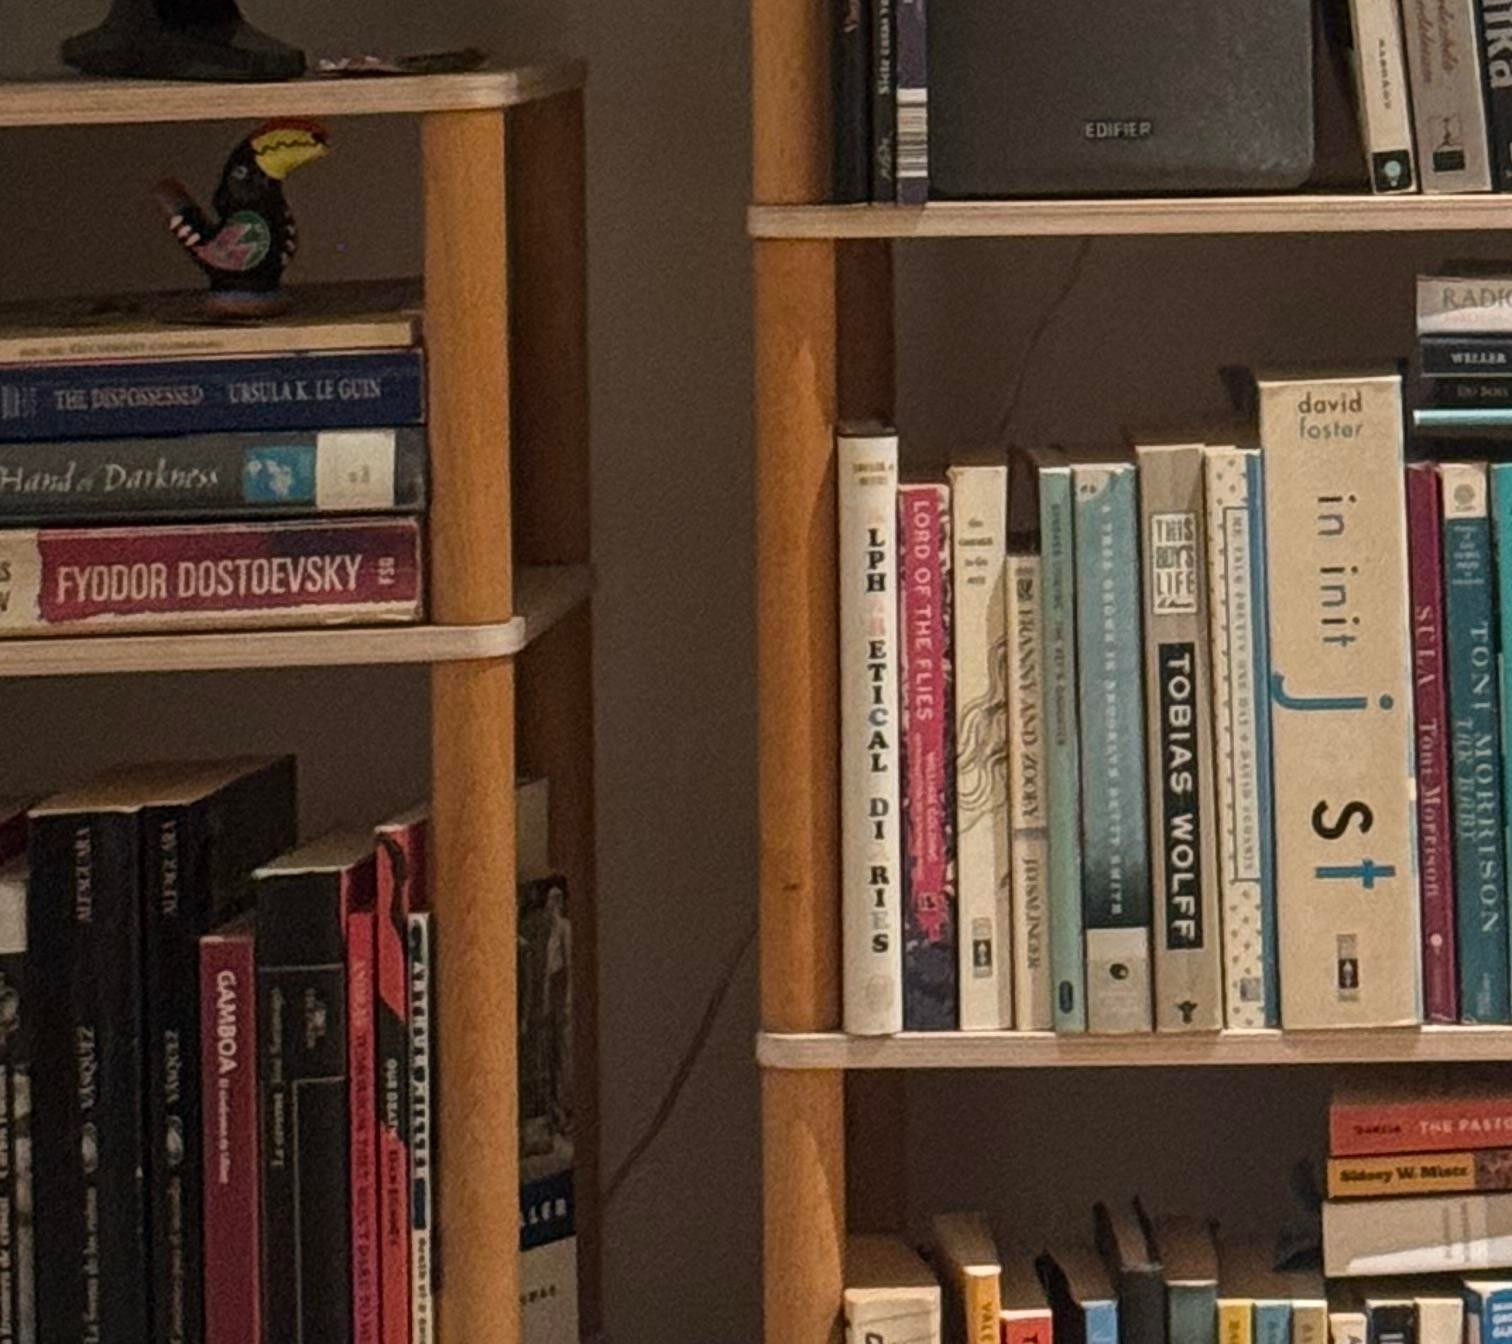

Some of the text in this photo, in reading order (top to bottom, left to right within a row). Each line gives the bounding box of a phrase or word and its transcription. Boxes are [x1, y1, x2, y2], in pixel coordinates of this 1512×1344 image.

[1085, 120, 1151, 138] EDIFIER
[105, 460, 218, 491] Darkness
[57, 555, 362, 603] FYODOR DOSTOEVSKY
[913, 501, 934, 721] LORD OF THE FLIES
[1168, 653, 1195, 940] TOBIAS WOLFF
[1469, 622, 1499, 933] TONI MORRISON
[217, 971, 235, 1073] GAMBOA
